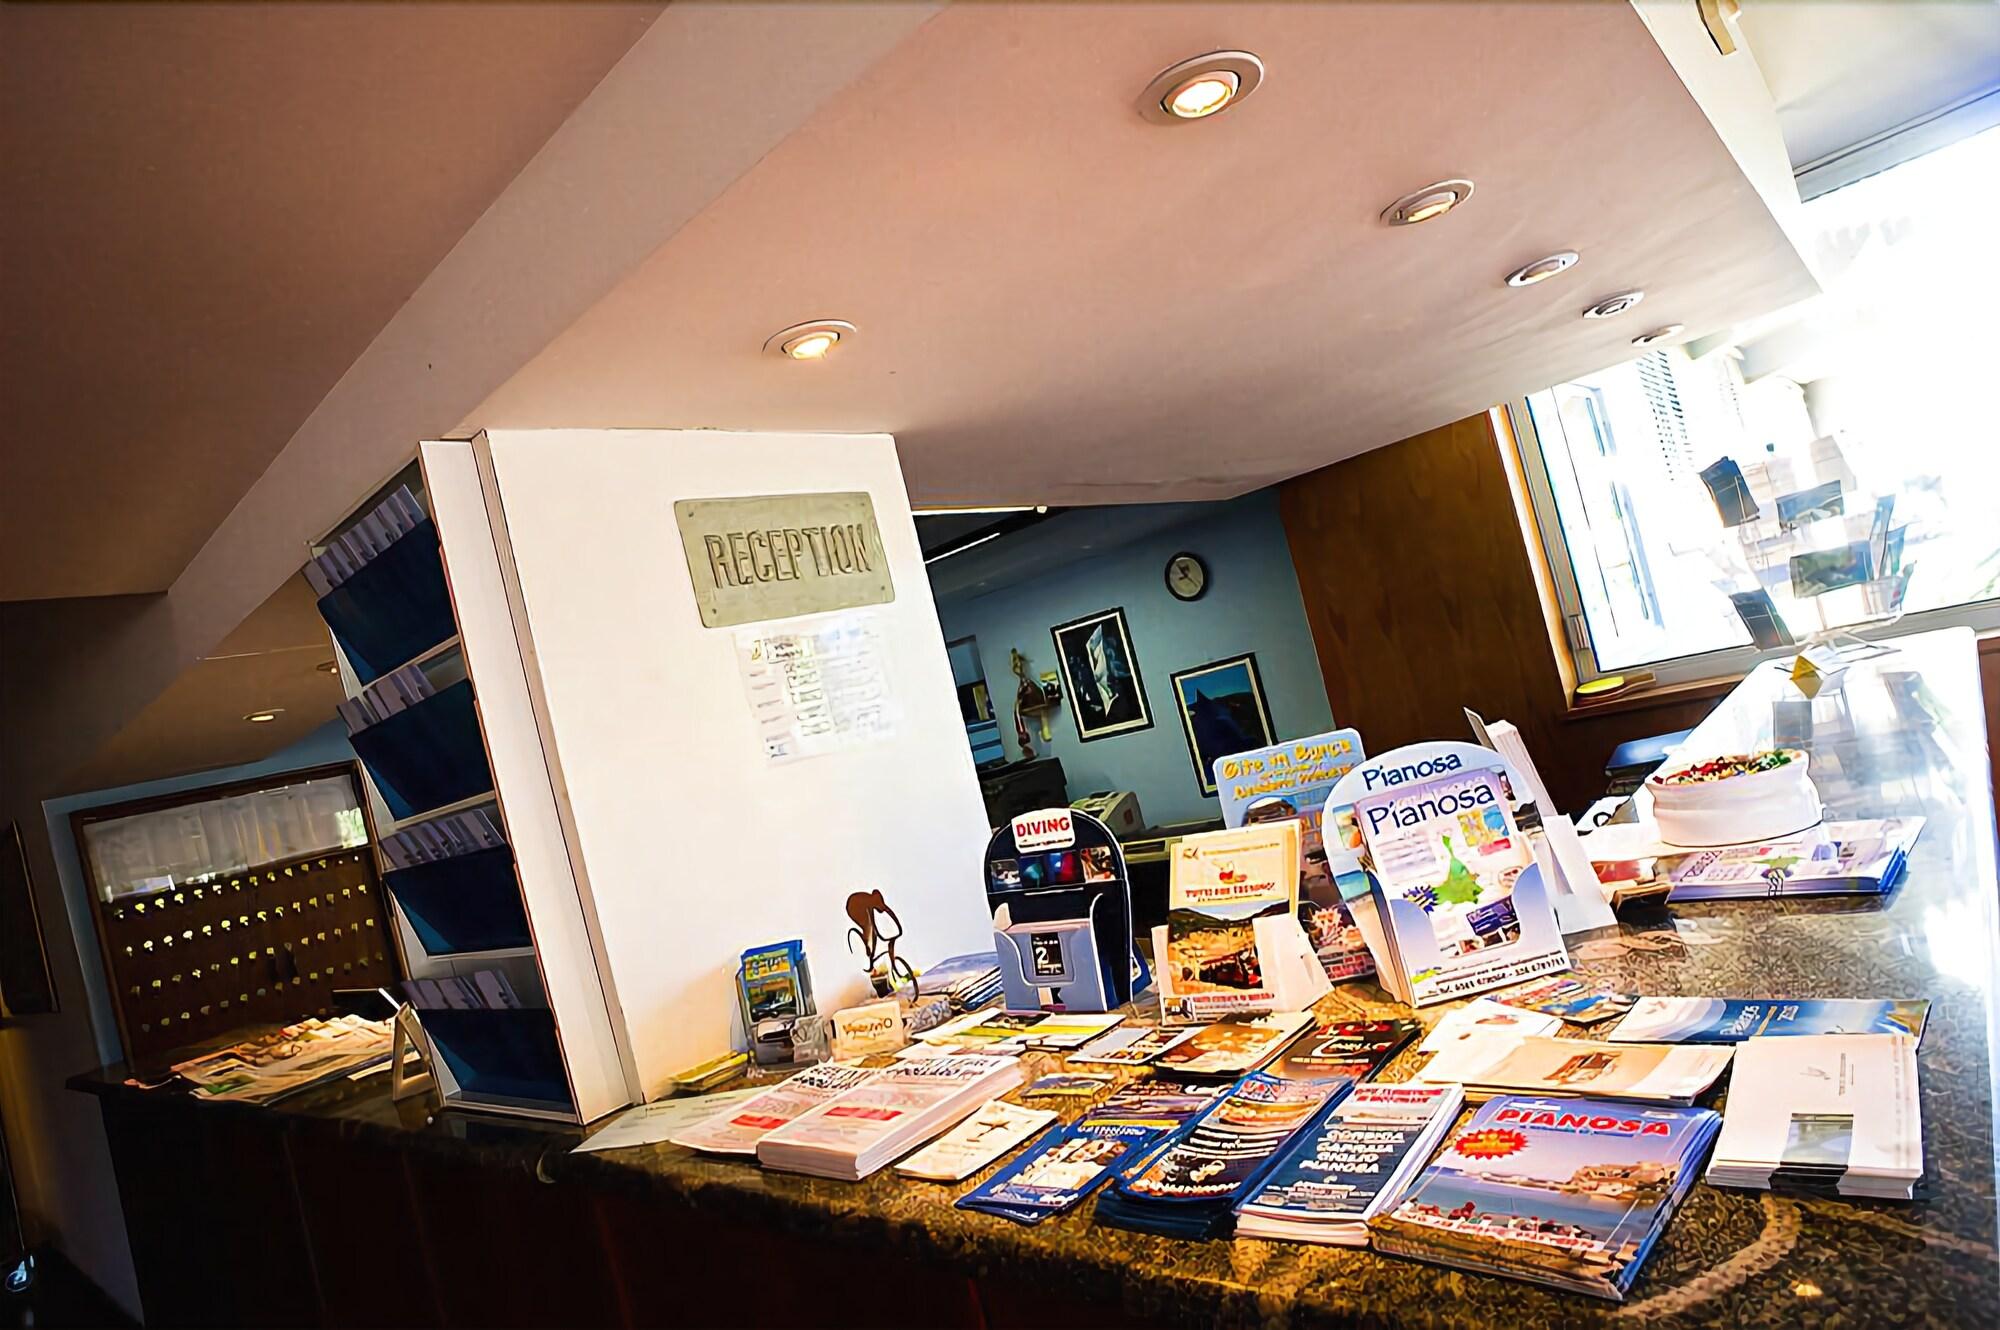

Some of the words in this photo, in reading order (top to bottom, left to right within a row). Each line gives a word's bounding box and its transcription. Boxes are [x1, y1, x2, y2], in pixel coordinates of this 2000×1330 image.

[704, 523, 873, 589] RECEPTION
[1362, 753, 1462, 791] Pianosa
[1016, 816, 1070, 838] DIVING
[1367, 783, 1496, 835] Pianosa
[1495, 1108, 1671, 1137] PIANOSA
